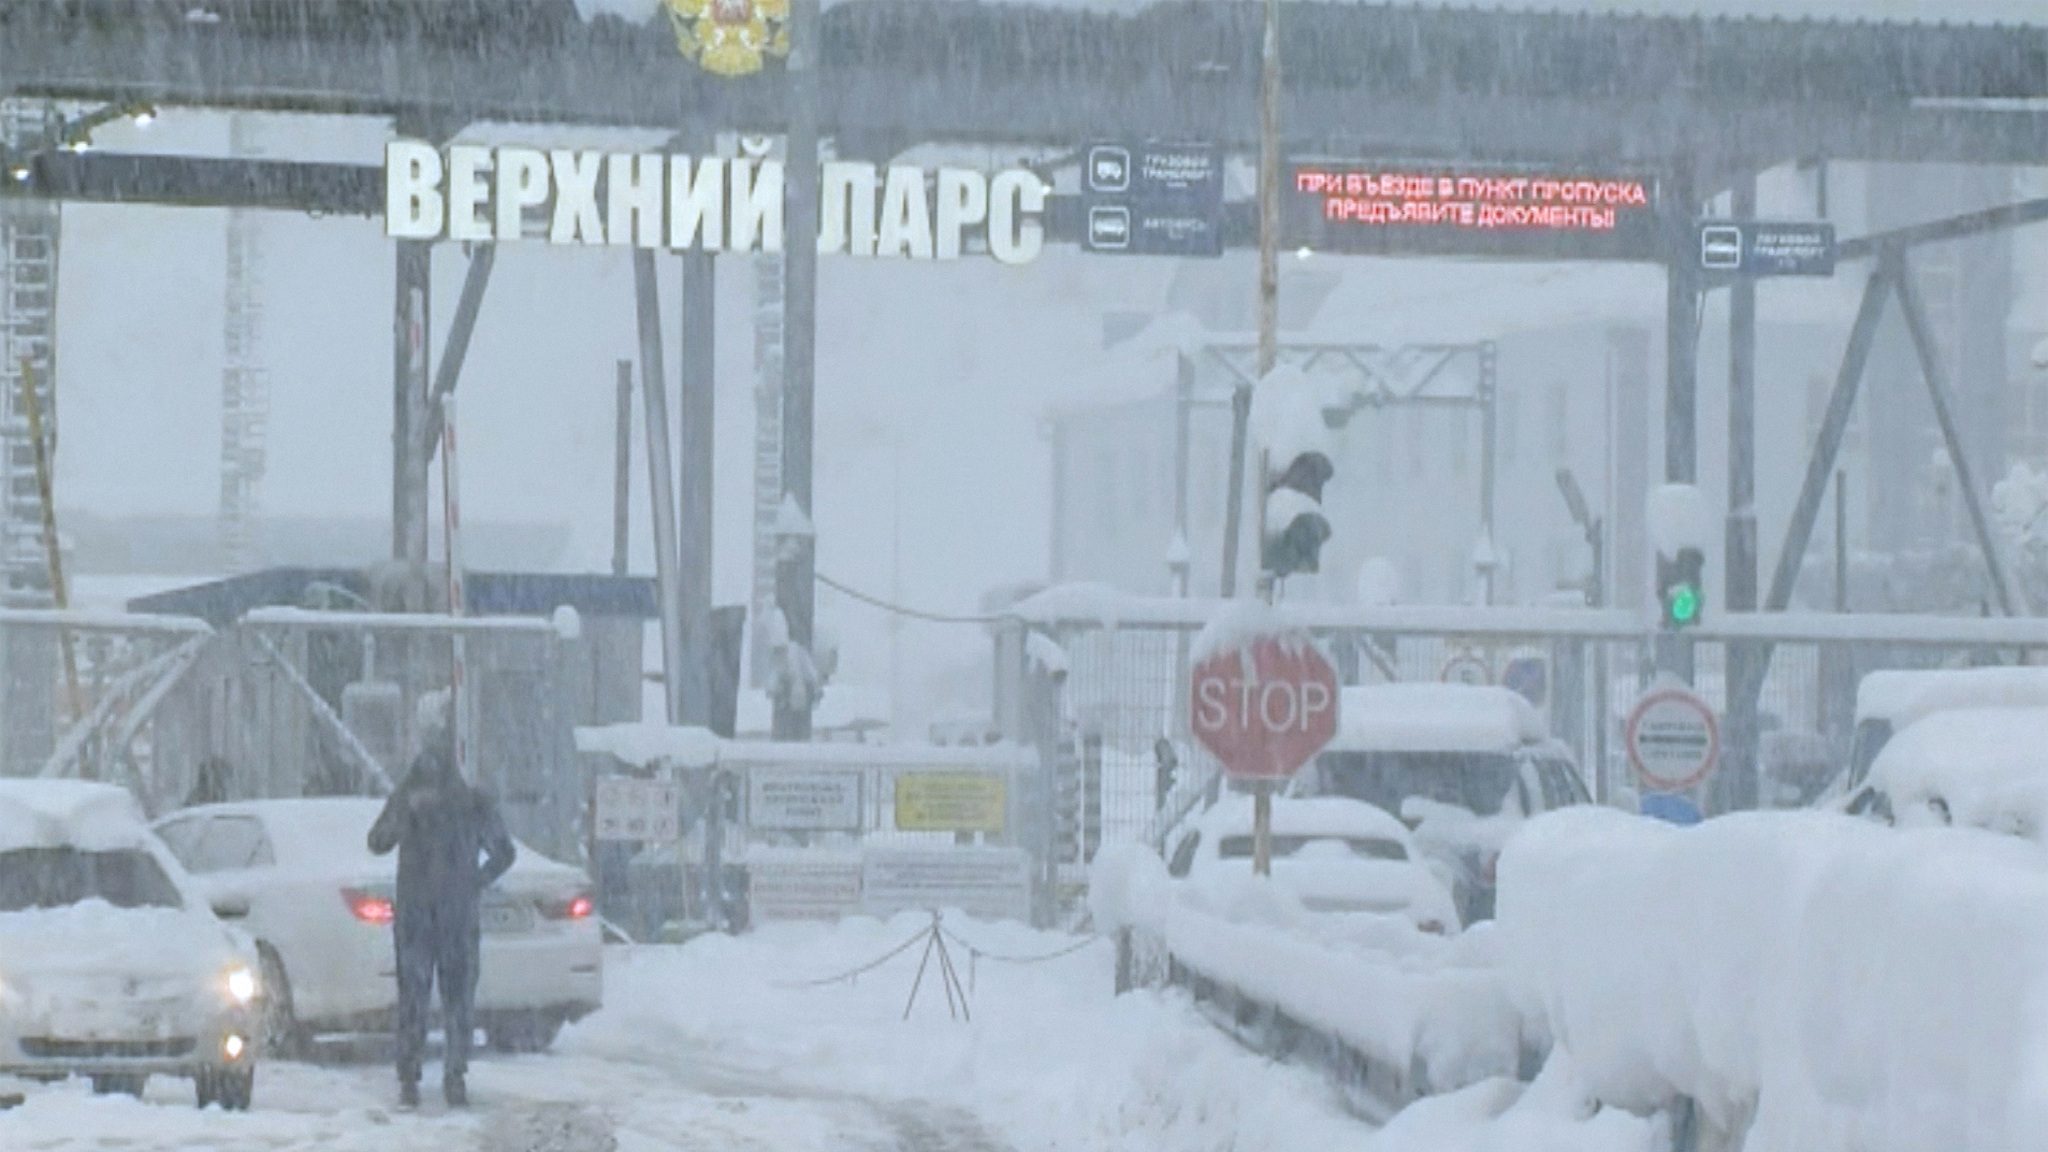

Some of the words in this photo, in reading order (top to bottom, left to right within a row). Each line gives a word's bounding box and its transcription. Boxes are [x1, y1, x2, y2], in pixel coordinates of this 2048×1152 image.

[385, 135, 785, 252] ВЕРХНИЙ
[816, 160, 1046, 264] ЛАРС
[1297, 172, 1343, 194] ПРИ
[1346, 173, 1434, 199] ВЪЕЗДЕ
[1438, 177, 1454, 198] В
[1458, 177, 1529, 201] ПУНКТ
[1531, 181, 1648, 206] ПРОПУСКА
[1198, 676, 1330, 734] STOP
